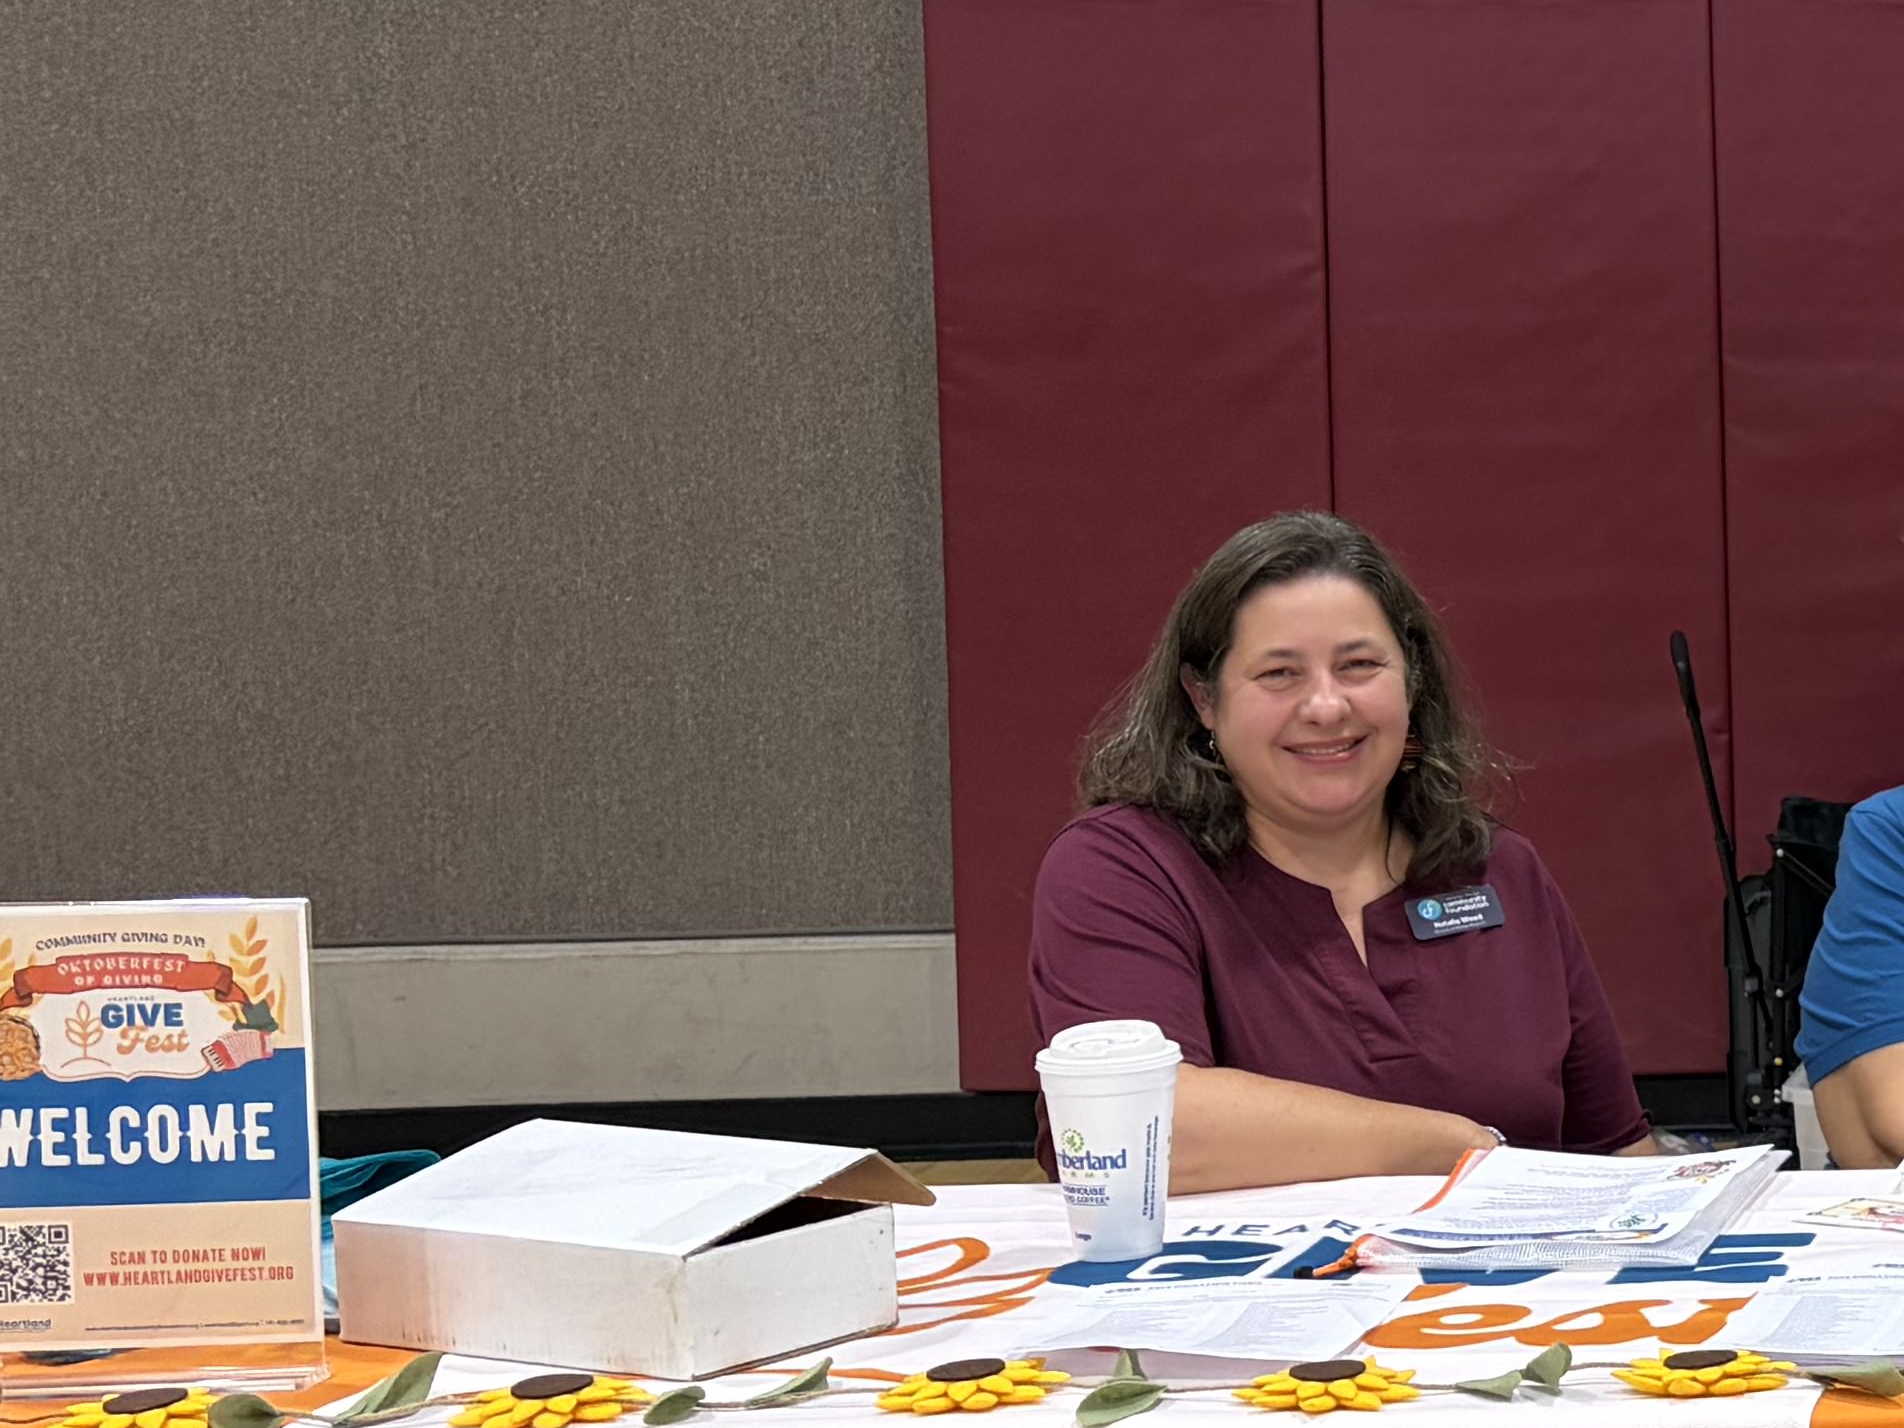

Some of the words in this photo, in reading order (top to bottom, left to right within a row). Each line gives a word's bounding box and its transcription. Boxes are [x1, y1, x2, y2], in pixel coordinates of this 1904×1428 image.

[35, 931, 117, 952] COMMUNITY
[120, 931, 169, 945] GIVING
[56, 955, 187, 977] OKTOBERFEST
[74, 975, 96, 987] OF
[102, 973, 164, 986] GIVING
[100, 1002, 184, 1029] GIVE
[116, 1026, 191, 1056] Fest
[0, 1102, 276, 1168] WELCOME
[110, 1250, 146, 1266] SCAN
[151, 1249, 168, 1264] TO
[172, 1248, 227, 1265] DONATE
[231, 1246, 267, 1262] NOW!
[83, 1266, 294, 1287] WWW.HEARTLANDGIVEFEST.ORG
